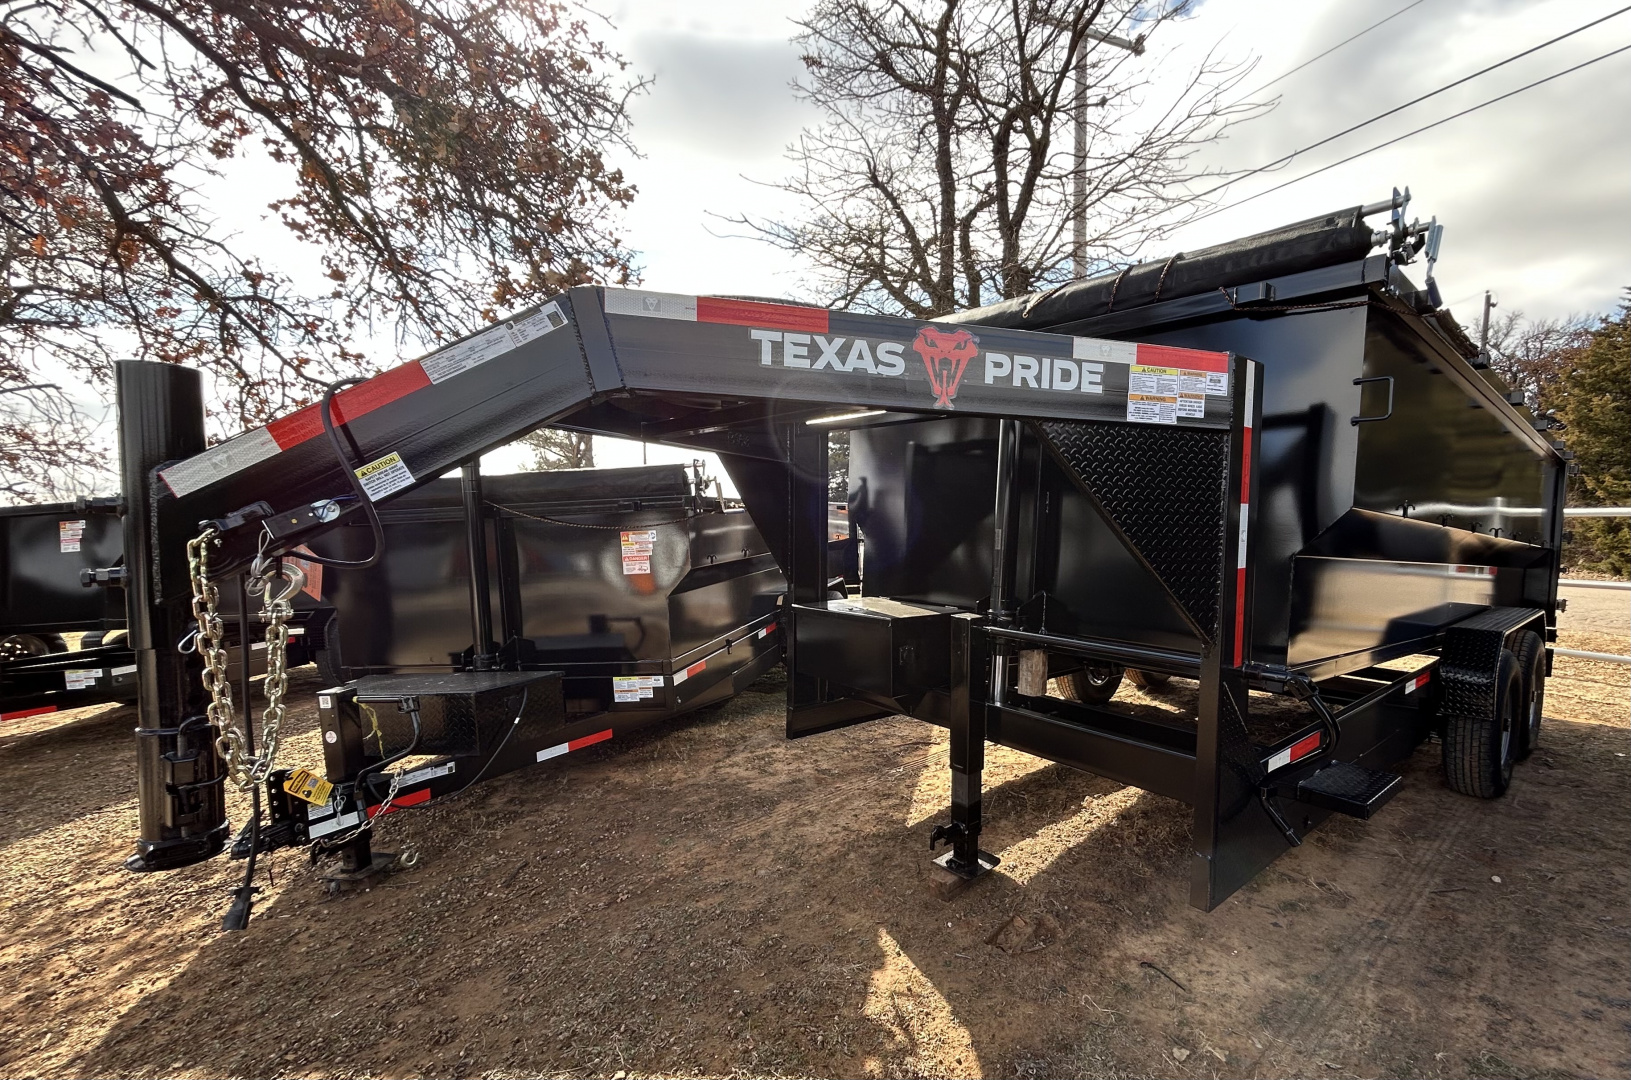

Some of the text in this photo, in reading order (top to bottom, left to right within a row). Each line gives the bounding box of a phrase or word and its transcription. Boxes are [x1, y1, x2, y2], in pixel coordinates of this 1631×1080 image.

[750, 330, 905, 375] TEXAS
[984, 352, 1104, 393] PRIDE
[366, 456, 395, 473] CAUTION
